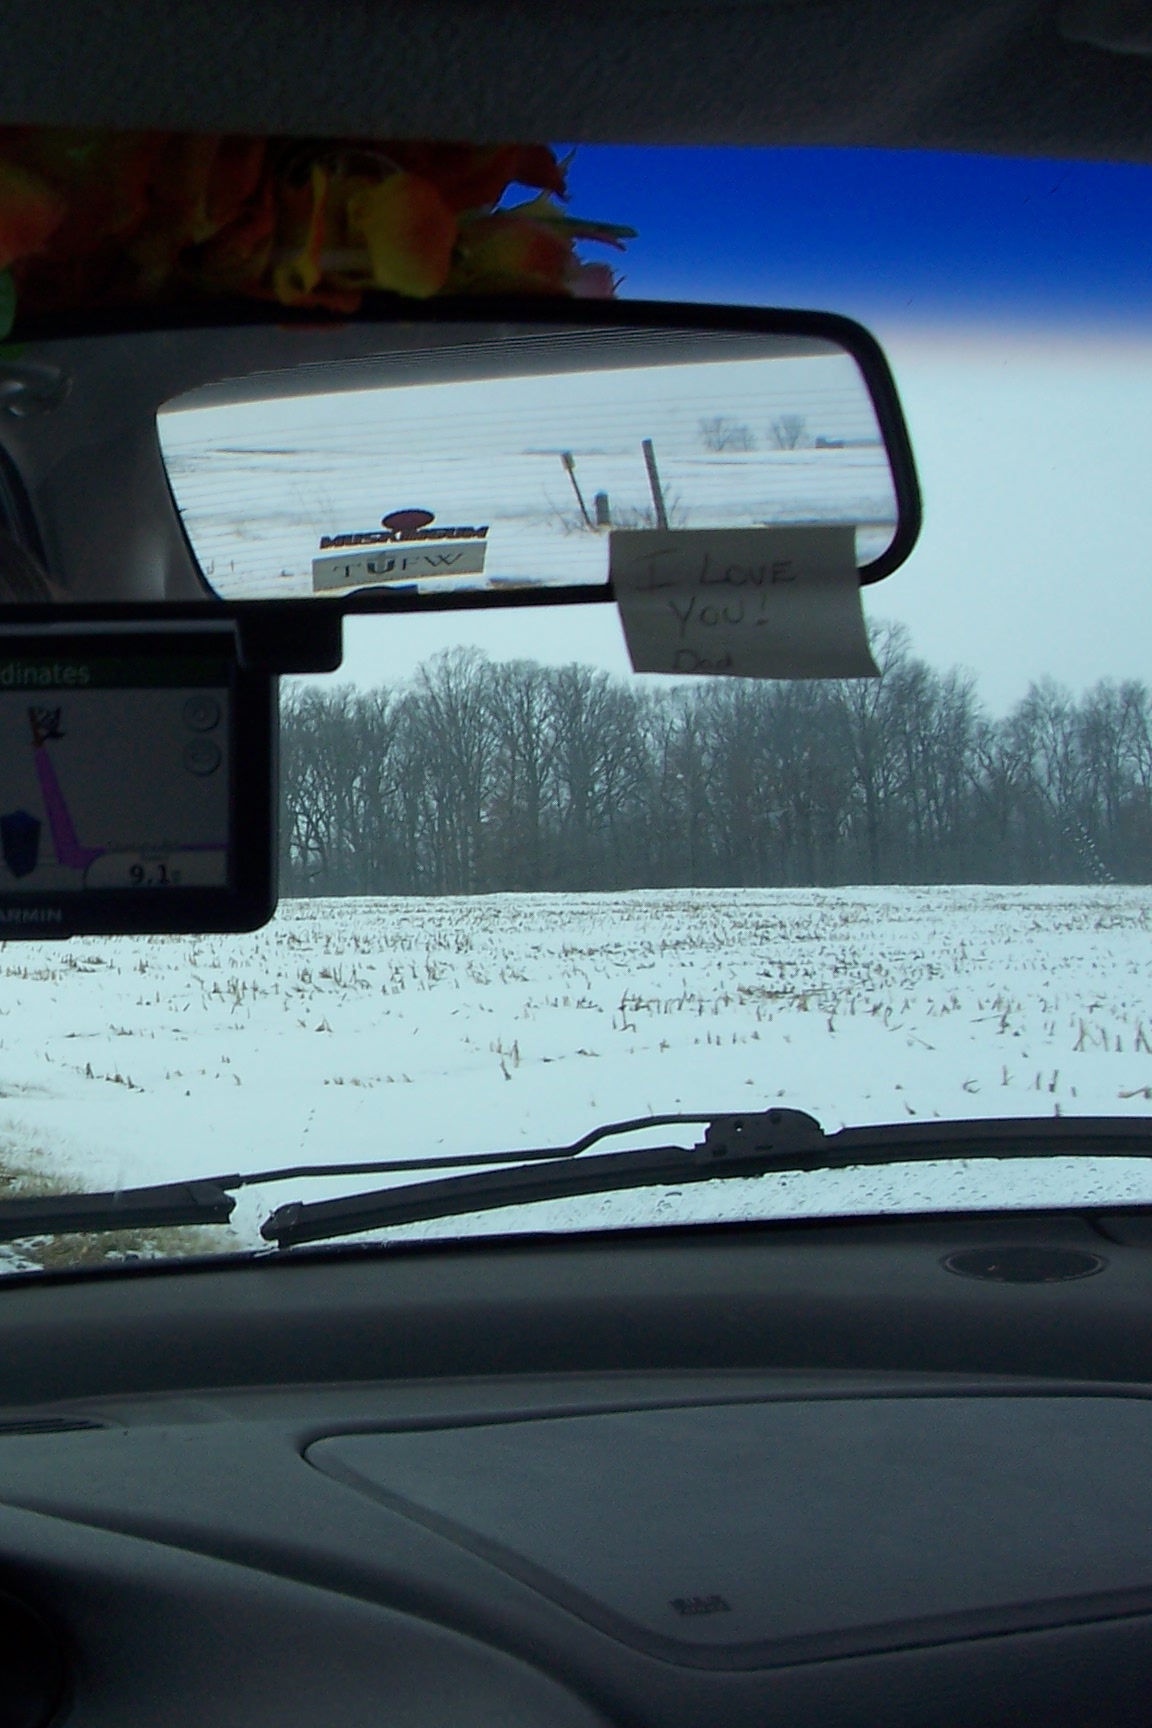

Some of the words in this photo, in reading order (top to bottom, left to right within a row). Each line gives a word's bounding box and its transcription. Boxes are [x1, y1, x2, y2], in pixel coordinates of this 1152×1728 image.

[632, 546, 680, 592] I
[698, 551, 798, 588] LOVE
[667, 595, 770, 638] YOU!
[672, 647, 735, 673] Dad
